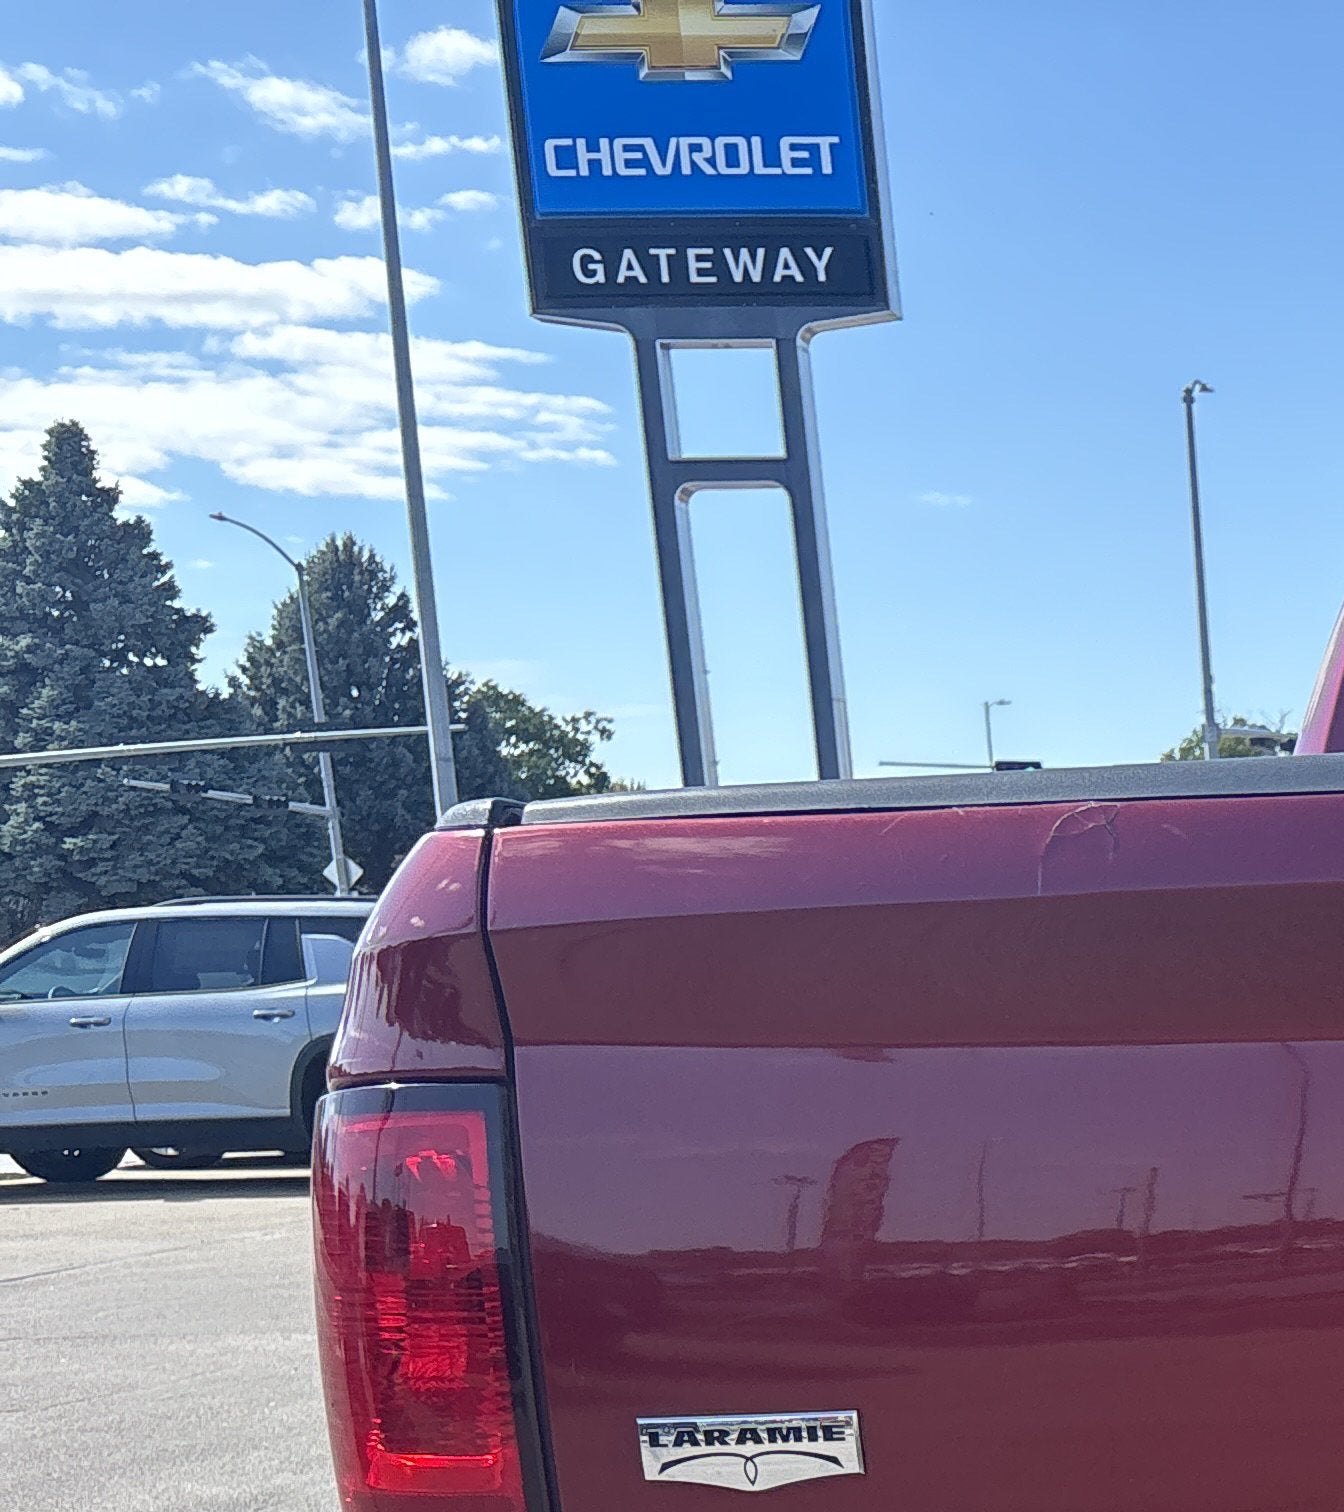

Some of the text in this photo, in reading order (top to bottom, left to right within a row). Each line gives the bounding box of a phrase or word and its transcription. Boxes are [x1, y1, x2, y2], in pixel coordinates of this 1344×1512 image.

[545, 136, 840, 177] CHEVROLET
[572, 246, 835, 284] GATEWAY
[648, 1424, 847, 1448] LARAMIE
